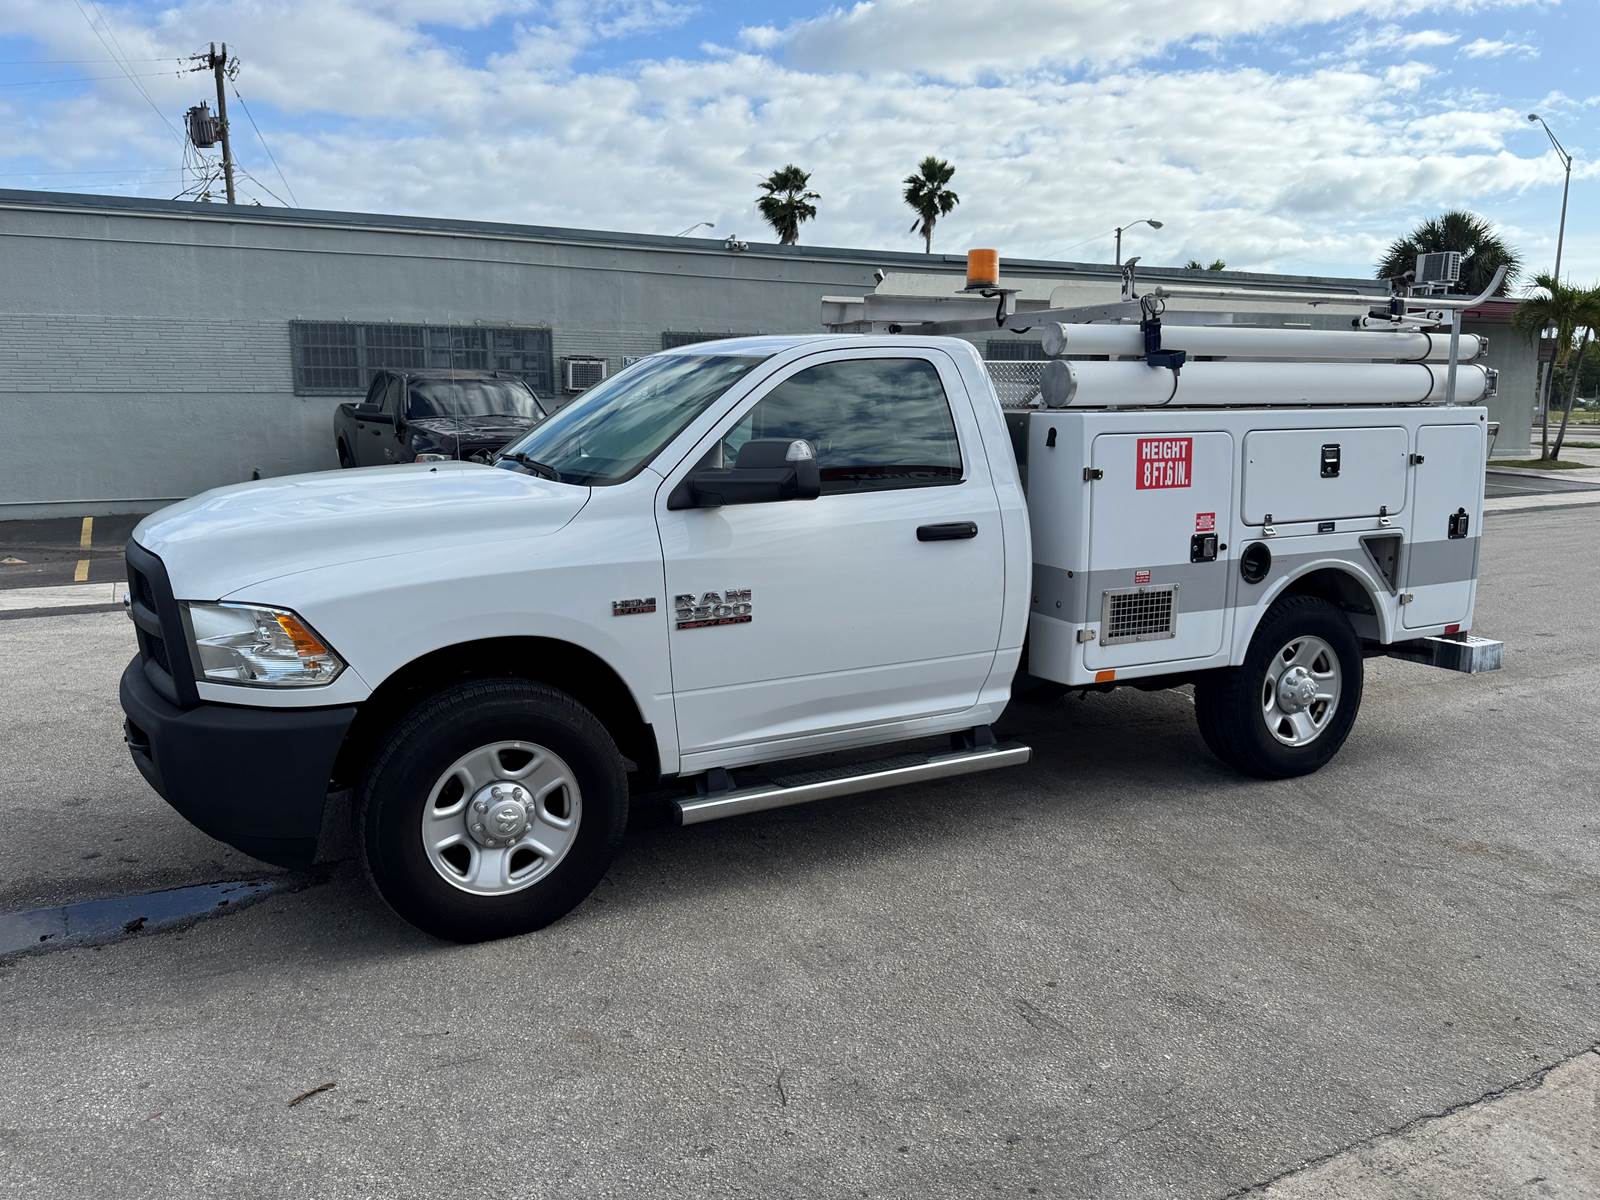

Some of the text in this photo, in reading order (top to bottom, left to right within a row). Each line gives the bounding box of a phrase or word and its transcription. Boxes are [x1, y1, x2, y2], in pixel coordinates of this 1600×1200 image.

[1142, 441, 1188, 459] HEIGHT
[612, 598, 656, 609] HEMI
[675, 589, 752, 608] RAM
[679, 616, 750, 629] HEAVY DUTY
